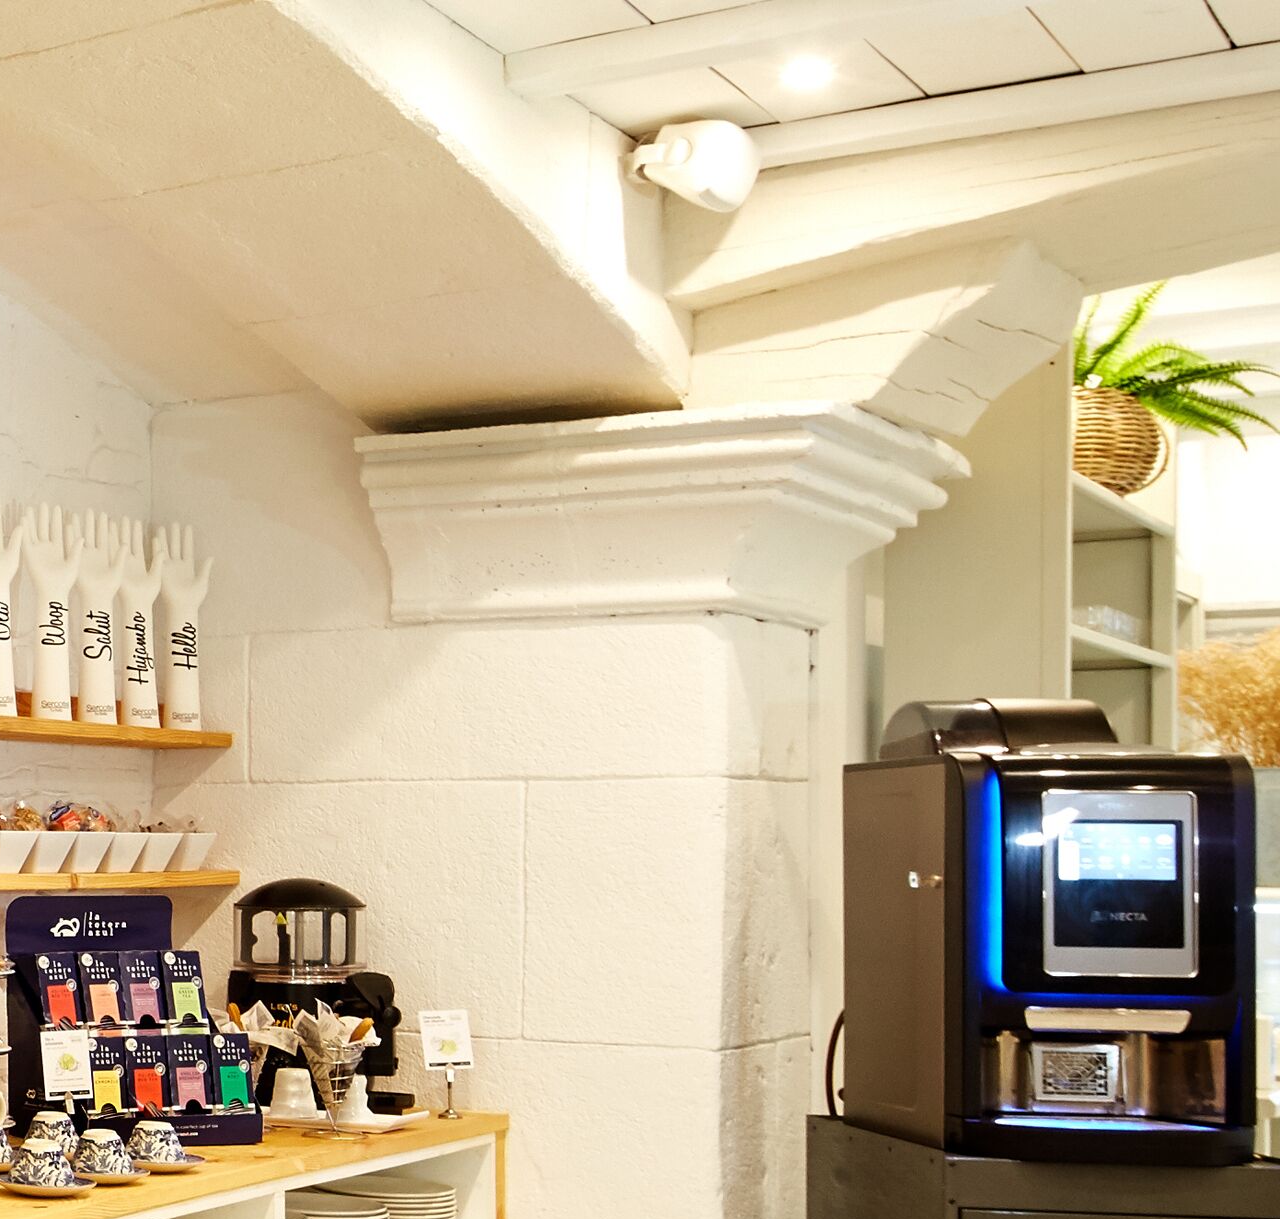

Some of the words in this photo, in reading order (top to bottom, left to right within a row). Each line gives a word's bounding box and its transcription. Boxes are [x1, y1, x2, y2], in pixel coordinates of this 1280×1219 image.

[83, 610, 112, 661] Salut
[126, 612, 154, 685] Hujambo
[171, 622, 197, 670] Hello
[88, 911, 100, 921] la
[88, 925, 114, 937] azul
[1109, 912, 1148, 922] NECTA
